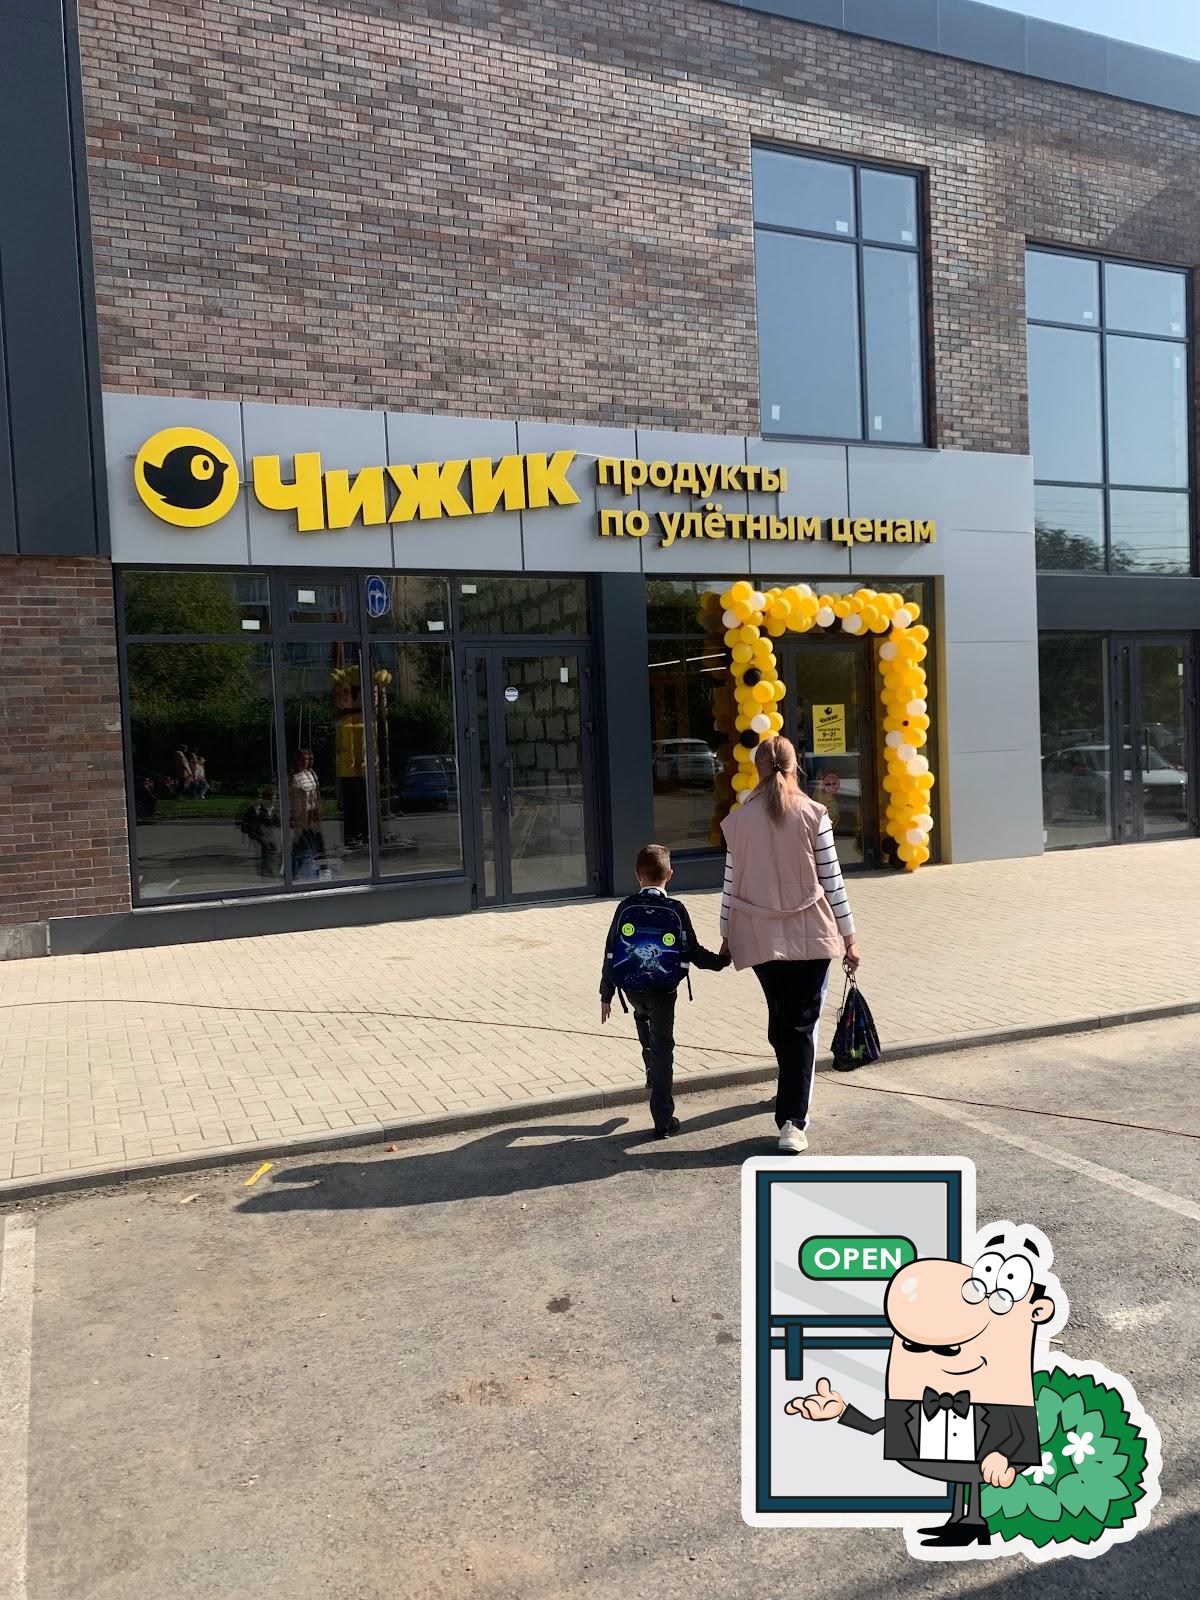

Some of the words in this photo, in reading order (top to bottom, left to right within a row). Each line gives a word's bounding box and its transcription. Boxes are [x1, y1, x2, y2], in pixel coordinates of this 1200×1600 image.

[253, 450, 581, 531] Чижик
[596, 458, 788, 499] продукты
[599, 508, 650, 537] по
[658, 503, 821, 547] улётным
[829, 516, 936, 548] ценам
